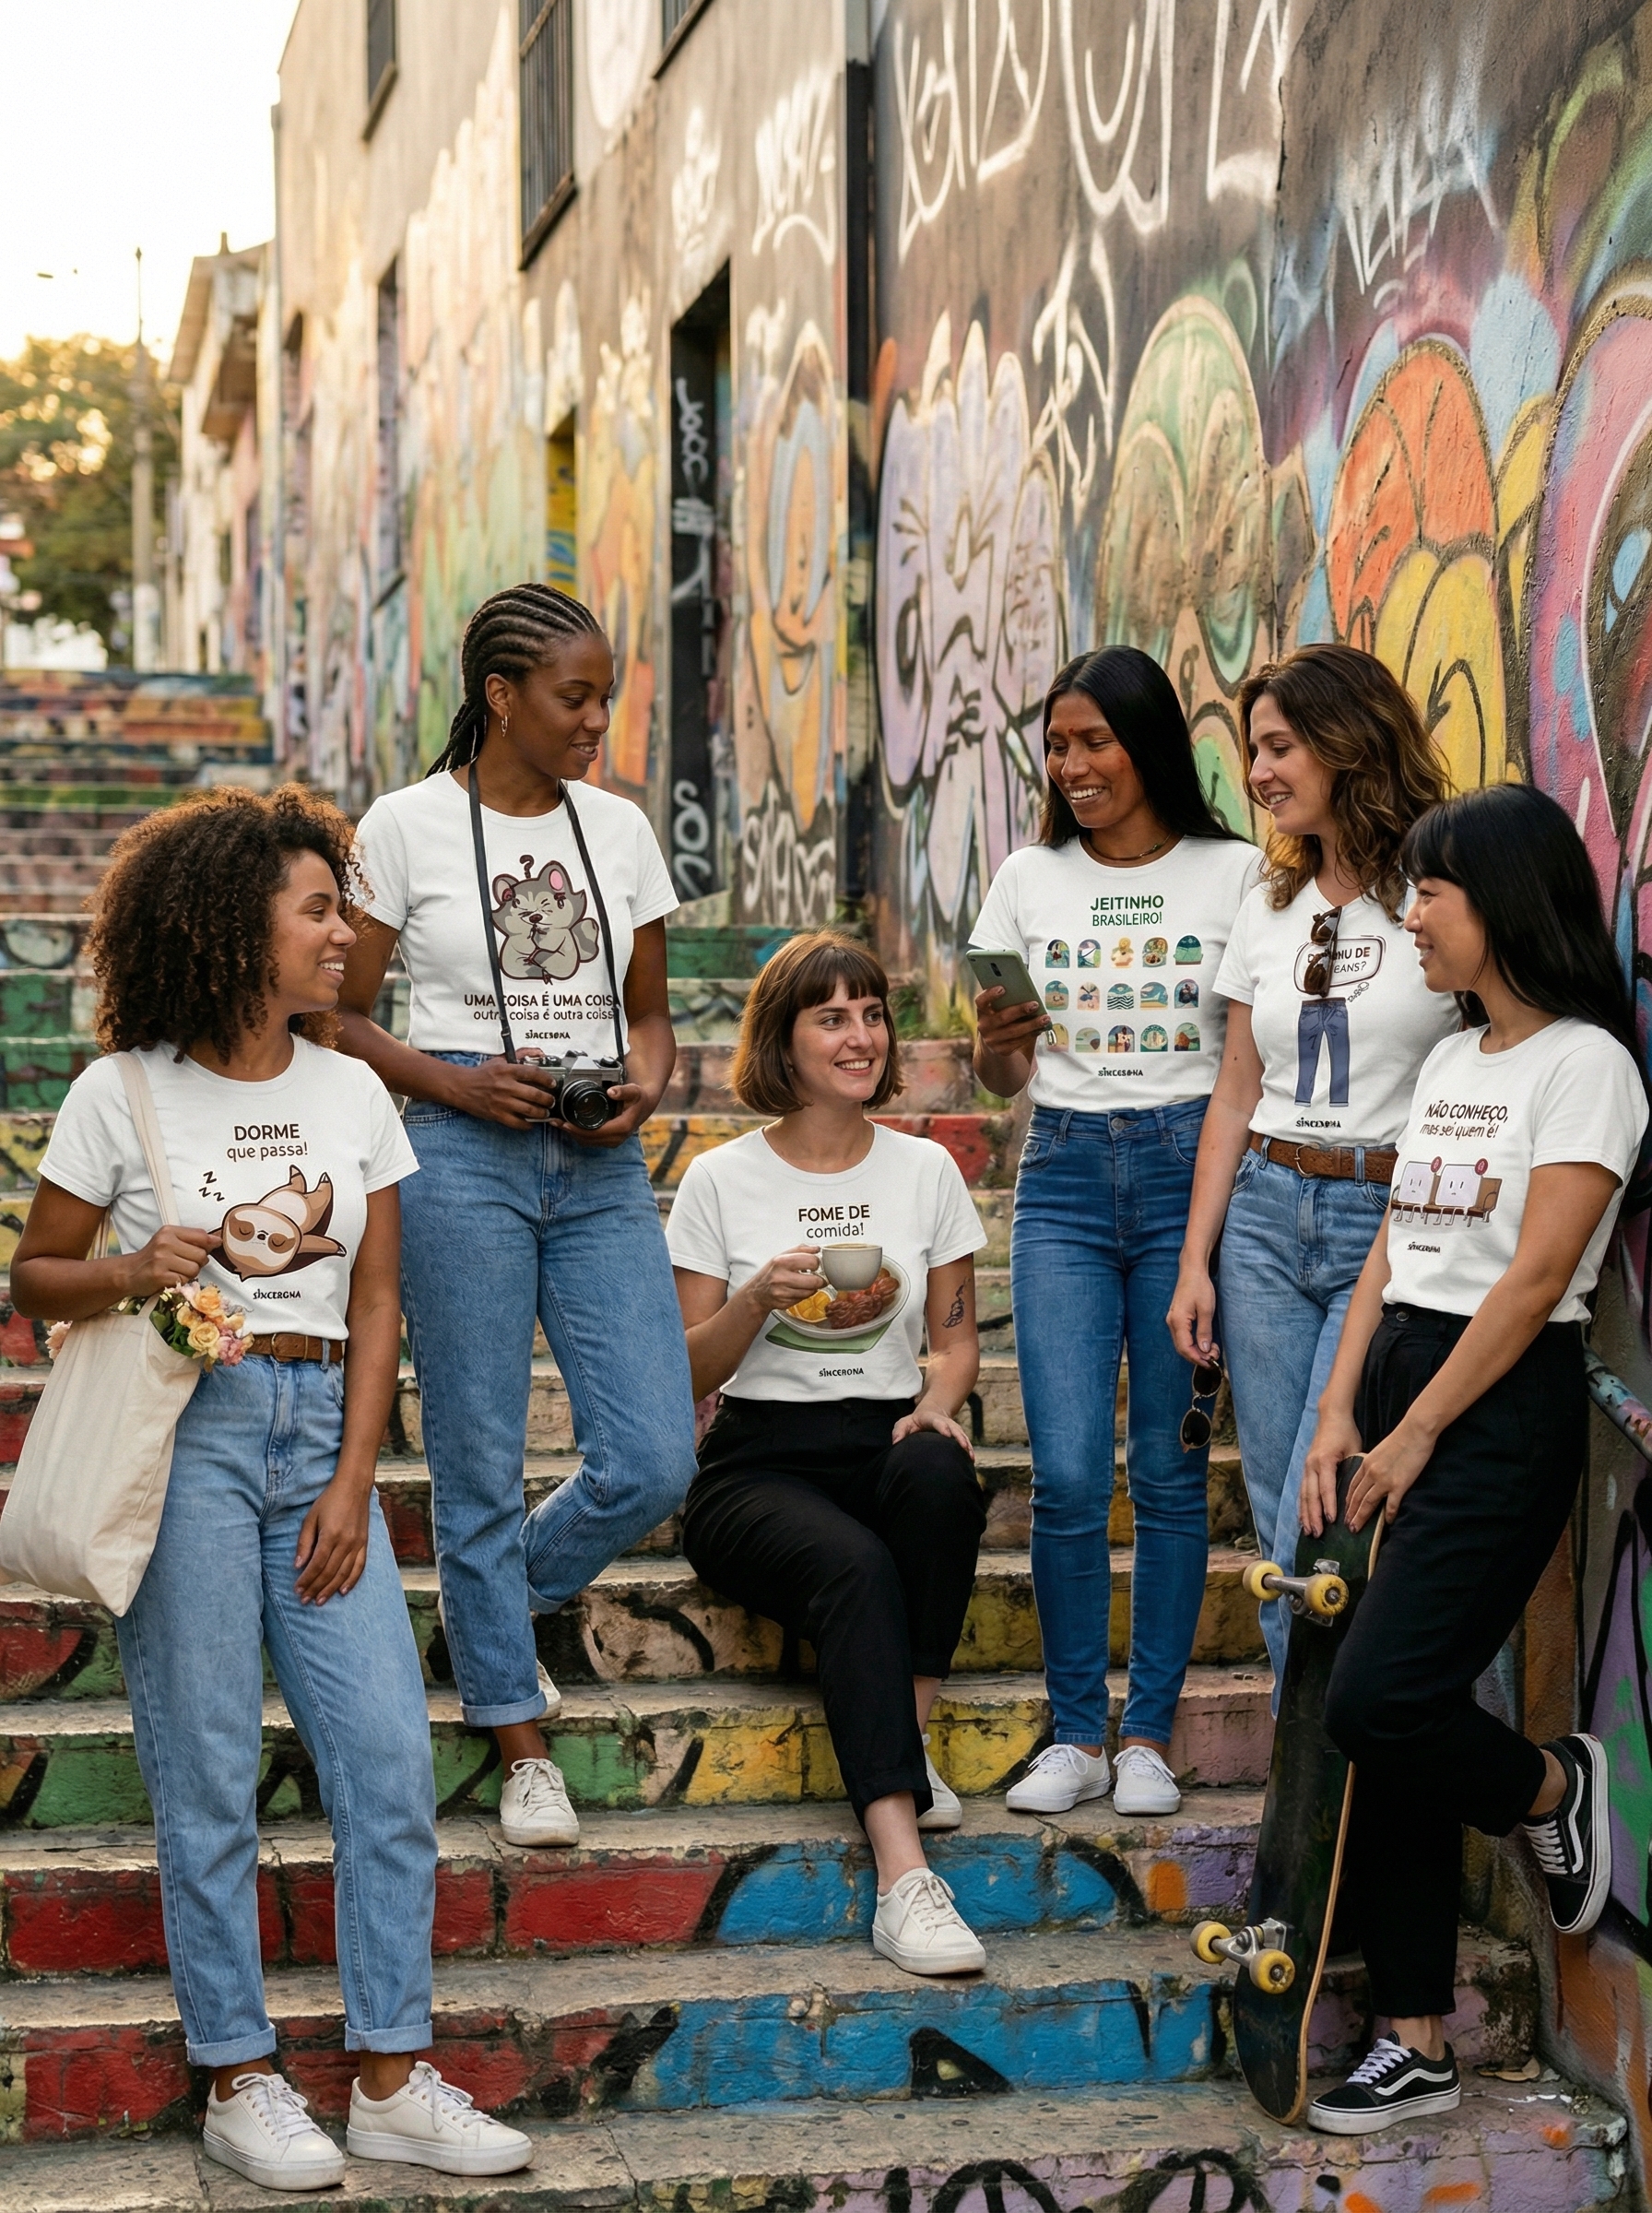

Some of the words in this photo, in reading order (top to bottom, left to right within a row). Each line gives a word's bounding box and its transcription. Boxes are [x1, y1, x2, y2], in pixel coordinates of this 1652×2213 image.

[1090, 894, 1164, 911] JEITINHO
[1092, 911, 1162, 927] BRASILEIRO!
[1355, 946, 1371, 958] DE
[1333, 960, 1367, 974] EANS?
[464, 994, 496, 1007] UMA
[542, 991, 549, 1007] É
[553, 994, 583, 1007] UMA
[584, 994, 613, 1007] COIS
[473, 1010, 500, 1021] outr
[509, 1008, 539, 1021] coisa
[542, 1009, 550, 1021] é
[552, 1010, 584, 1021] outra
[1424, 1099, 1449, 1118] NÃO
[1449, 1104, 1509, 1126] CONHEÇO,
[233, 1123, 301, 1142] DORME
[1455, 1125, 1485, 1142] quem
[1486, 1123, 1500, 1139] é!
[226, 1147, 256, 1163] que
[260, 1142, 308, 1162] passa!
[797, 1206, 844, 1223] FOME
[848, 1204, 871, 1219] DE
[806, 1223, 865, 1239] comida!
